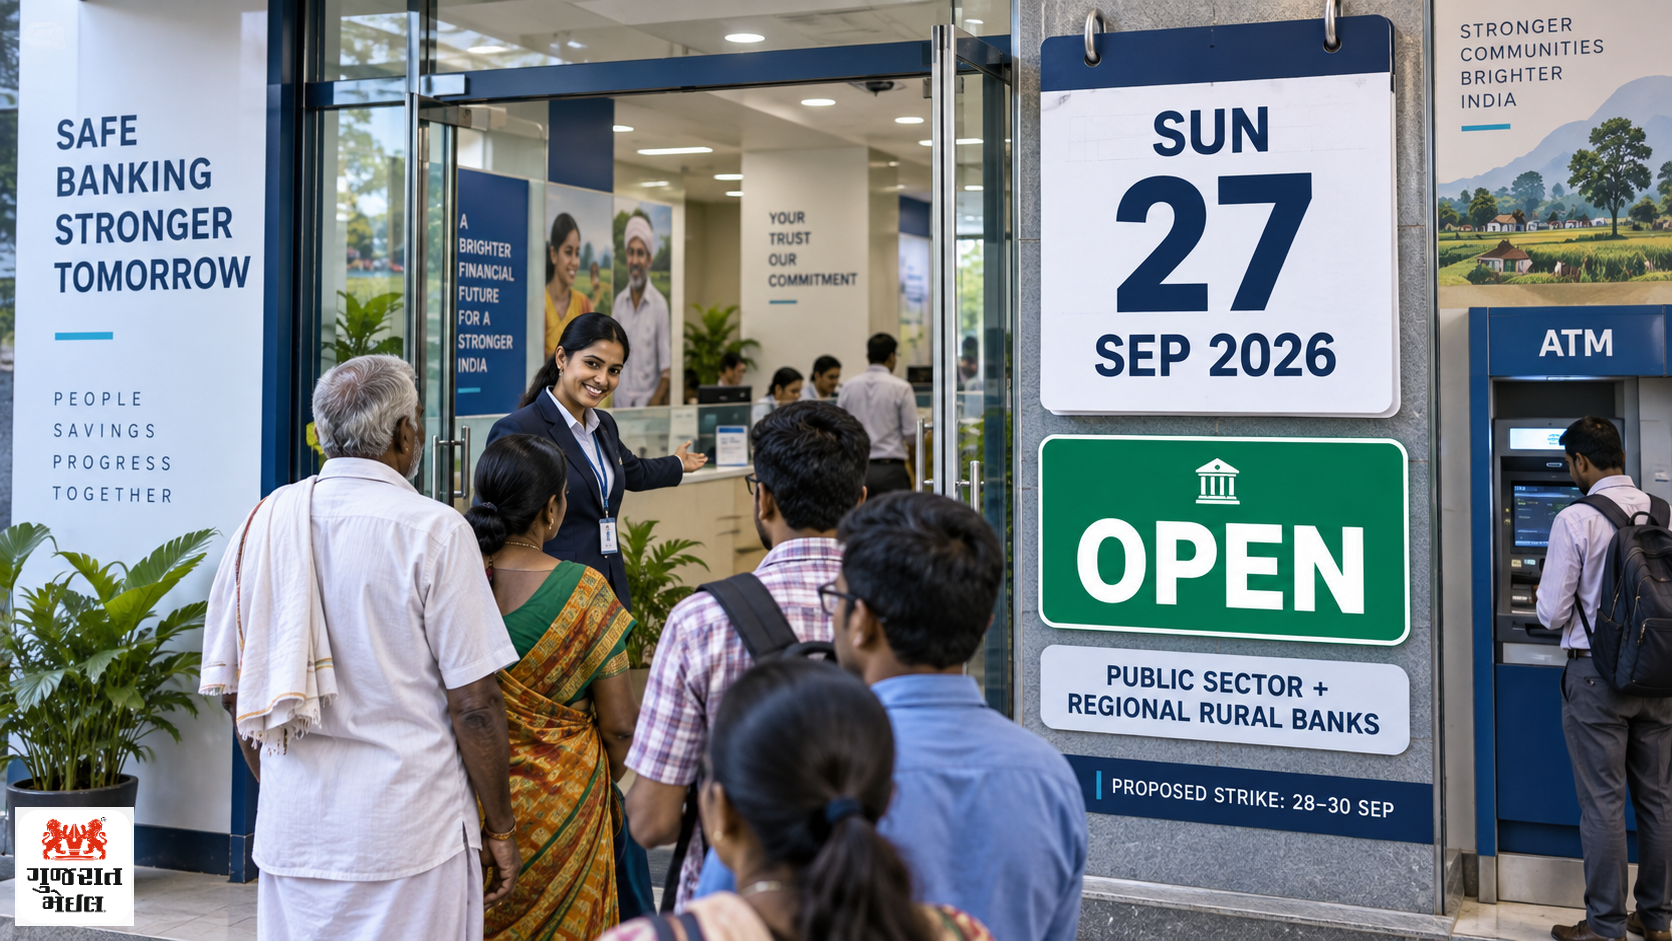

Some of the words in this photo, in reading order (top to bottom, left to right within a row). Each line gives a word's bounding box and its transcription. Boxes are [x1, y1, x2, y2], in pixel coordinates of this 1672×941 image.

[1460, 18, 1572, 39] STRONGER
[1460, 39, 1604, 62] COMMUNITIES
[1461, 66, 1562, 85] BRIGHTER
[1461, 92, 1516, 109] INDIA
[56, 115, 137, 150] SAFE
[1153, 106, 1268, 156] SUN
[56, 157, 212, 197] BANKING
[55, 206, 233, 245] STRONGER
[459, 214, 468, 229] A
[769, 211, 805, 225] YOUR
[459, 238, 511, 259] BRIGHTER
[769, 231, 812, 246] TRUST
[1116, 172, 1312, 312] 27
[768, 252, 797, 267] OUR
[54, 255, 251, 293] TOMORROW
[459, 262, 515, 282] FINANCIAL
[768, 272, 858, 288] COMMITMENT
[459, 285, 499, 304] FUTURE
[459, 310, 479, 325] FOR
[482, 311, 491, 326] A
[458, 333, 513, 351] STRONGER
[1539, 329, 1613, 356] ATM
[1095, 333, 1191, 377] SEP
[1209, 332, 1336, 377] 2026
[458, 357, 488, 374] INDIA
[54, 391, 142, 407] PEOPLE
[53, 423, 156, 439] SAVINGS
[53, 455, 172, 471] PROGRESS
[52, 486, 172, 503] TOGETHER
[1077, 518, 1365, 615] OPEN
[1107, 665, 1195, 691] PUBLIC
[1203, 671, 1303, 698] SECTOR
[1067, 693, 1191, 723] REGIONAL
[1200, 702, 1283, 728] RURAL
[1292, 708, 1380, 735] BANKS
[1112, 778, 1207, 802] PROPOSED
[1214, 787, 1285, 810] STRIKE:
[1358, 800, 1394, 819] SEP
